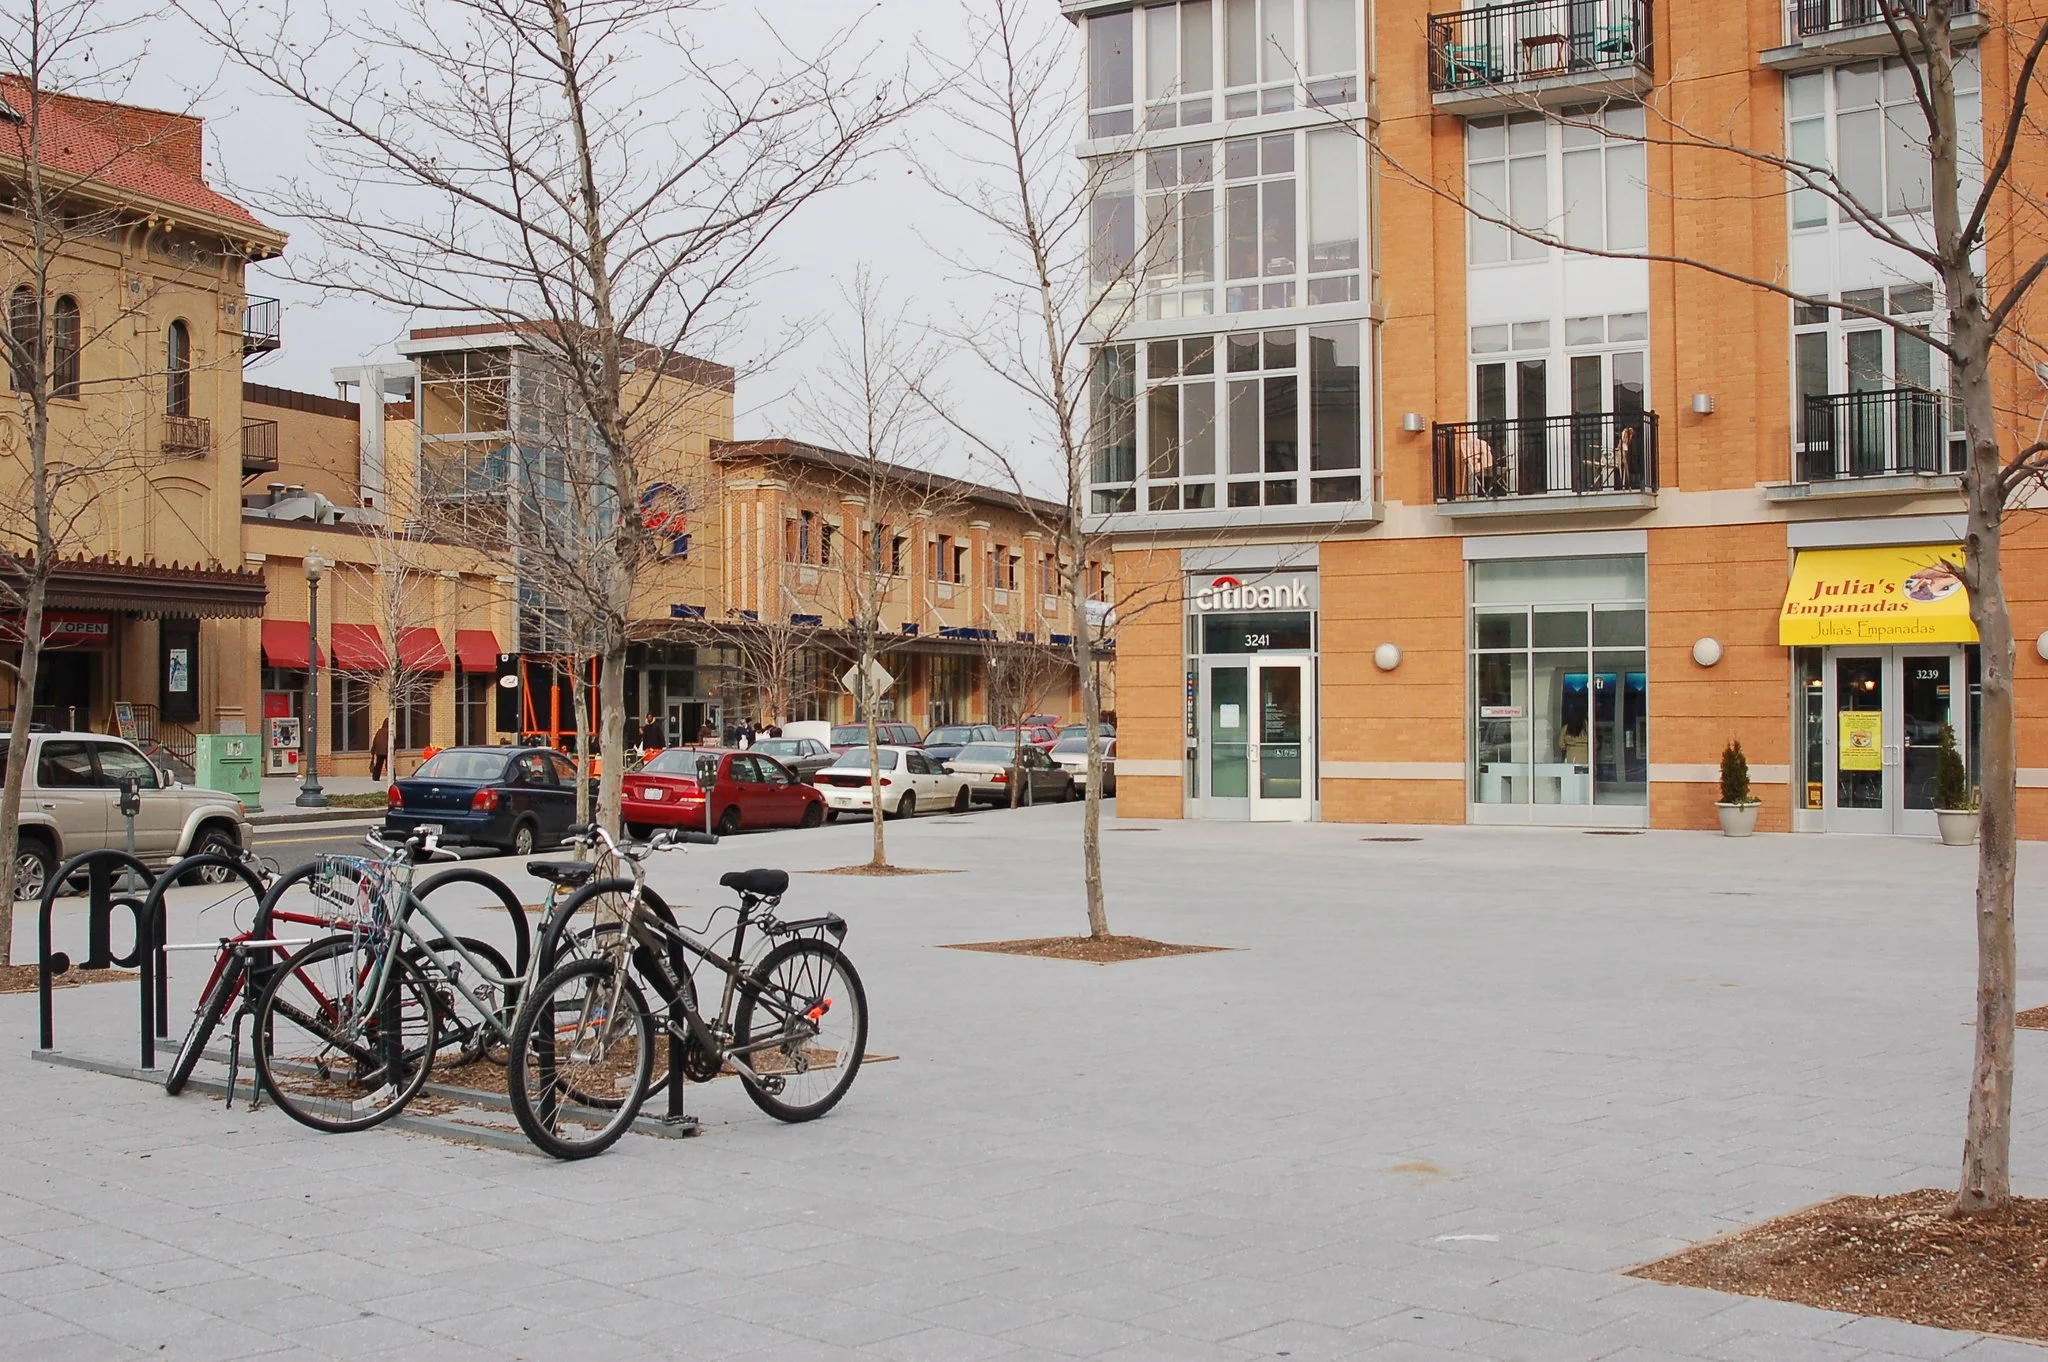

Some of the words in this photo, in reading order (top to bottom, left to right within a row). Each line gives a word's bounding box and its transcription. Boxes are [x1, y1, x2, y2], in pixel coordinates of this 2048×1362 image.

[1196, 577, 1309, 610] citibank
[1808, 578, 1896, 600] Julia's
[1786, 599, 1909, 617] Empanadas
[65, 622, 104, 633] OPEN
[1811, 620, 1852, 639] Julia's
[1858, 619, 1936, 641] Empanadas
[1244, 634, 1270, 647] 3241
[1915, 669, 1939, 680] 3239
